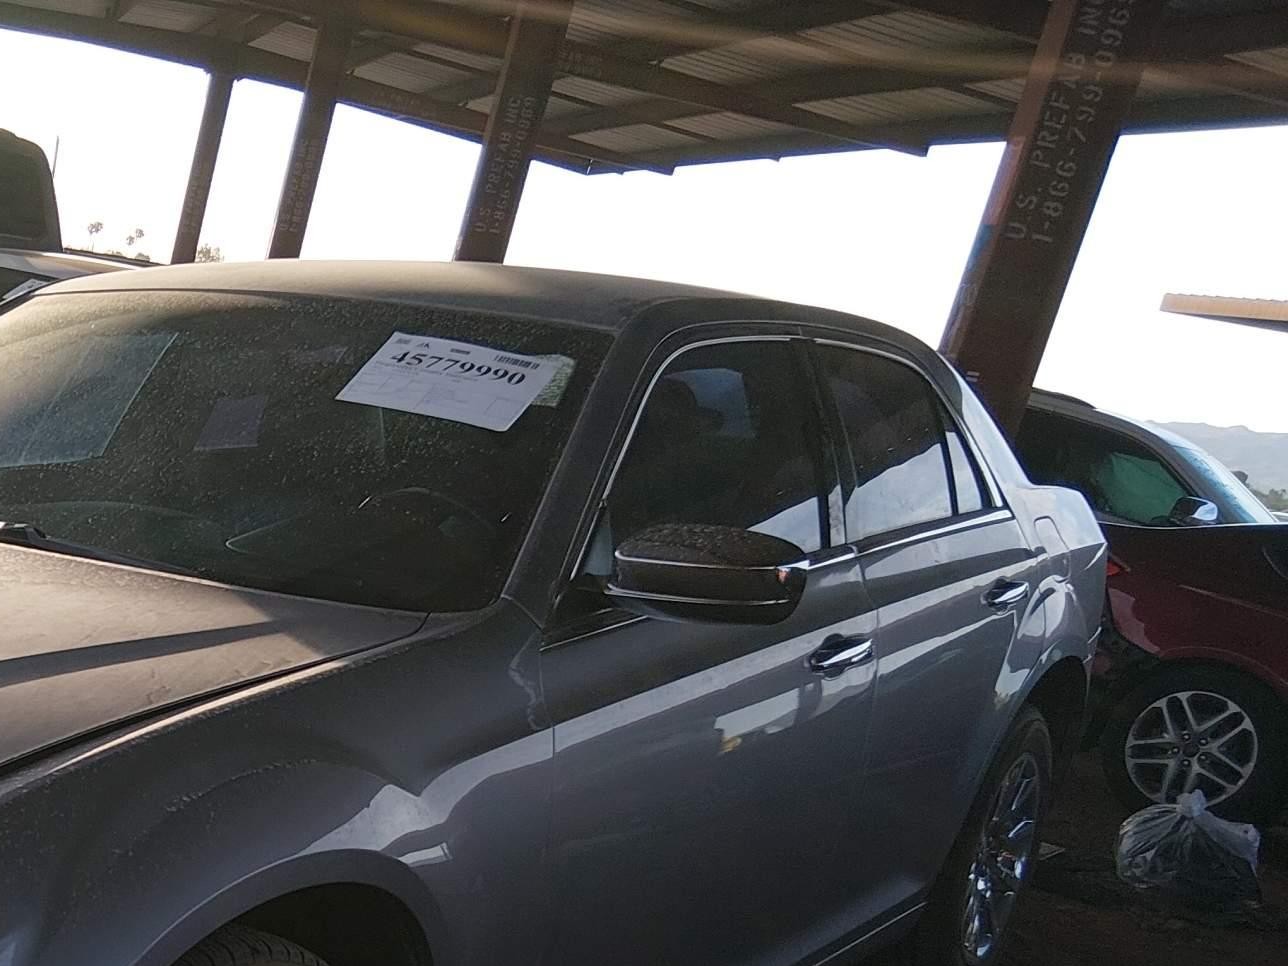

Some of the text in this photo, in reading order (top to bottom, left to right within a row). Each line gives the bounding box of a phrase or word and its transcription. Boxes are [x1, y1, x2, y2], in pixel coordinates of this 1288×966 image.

[1031, 53, 1086, 168] PREFAB
[1031, 0, 1133, 243] 1-866-799-096
[390, 351, 527, 386] 45779990
